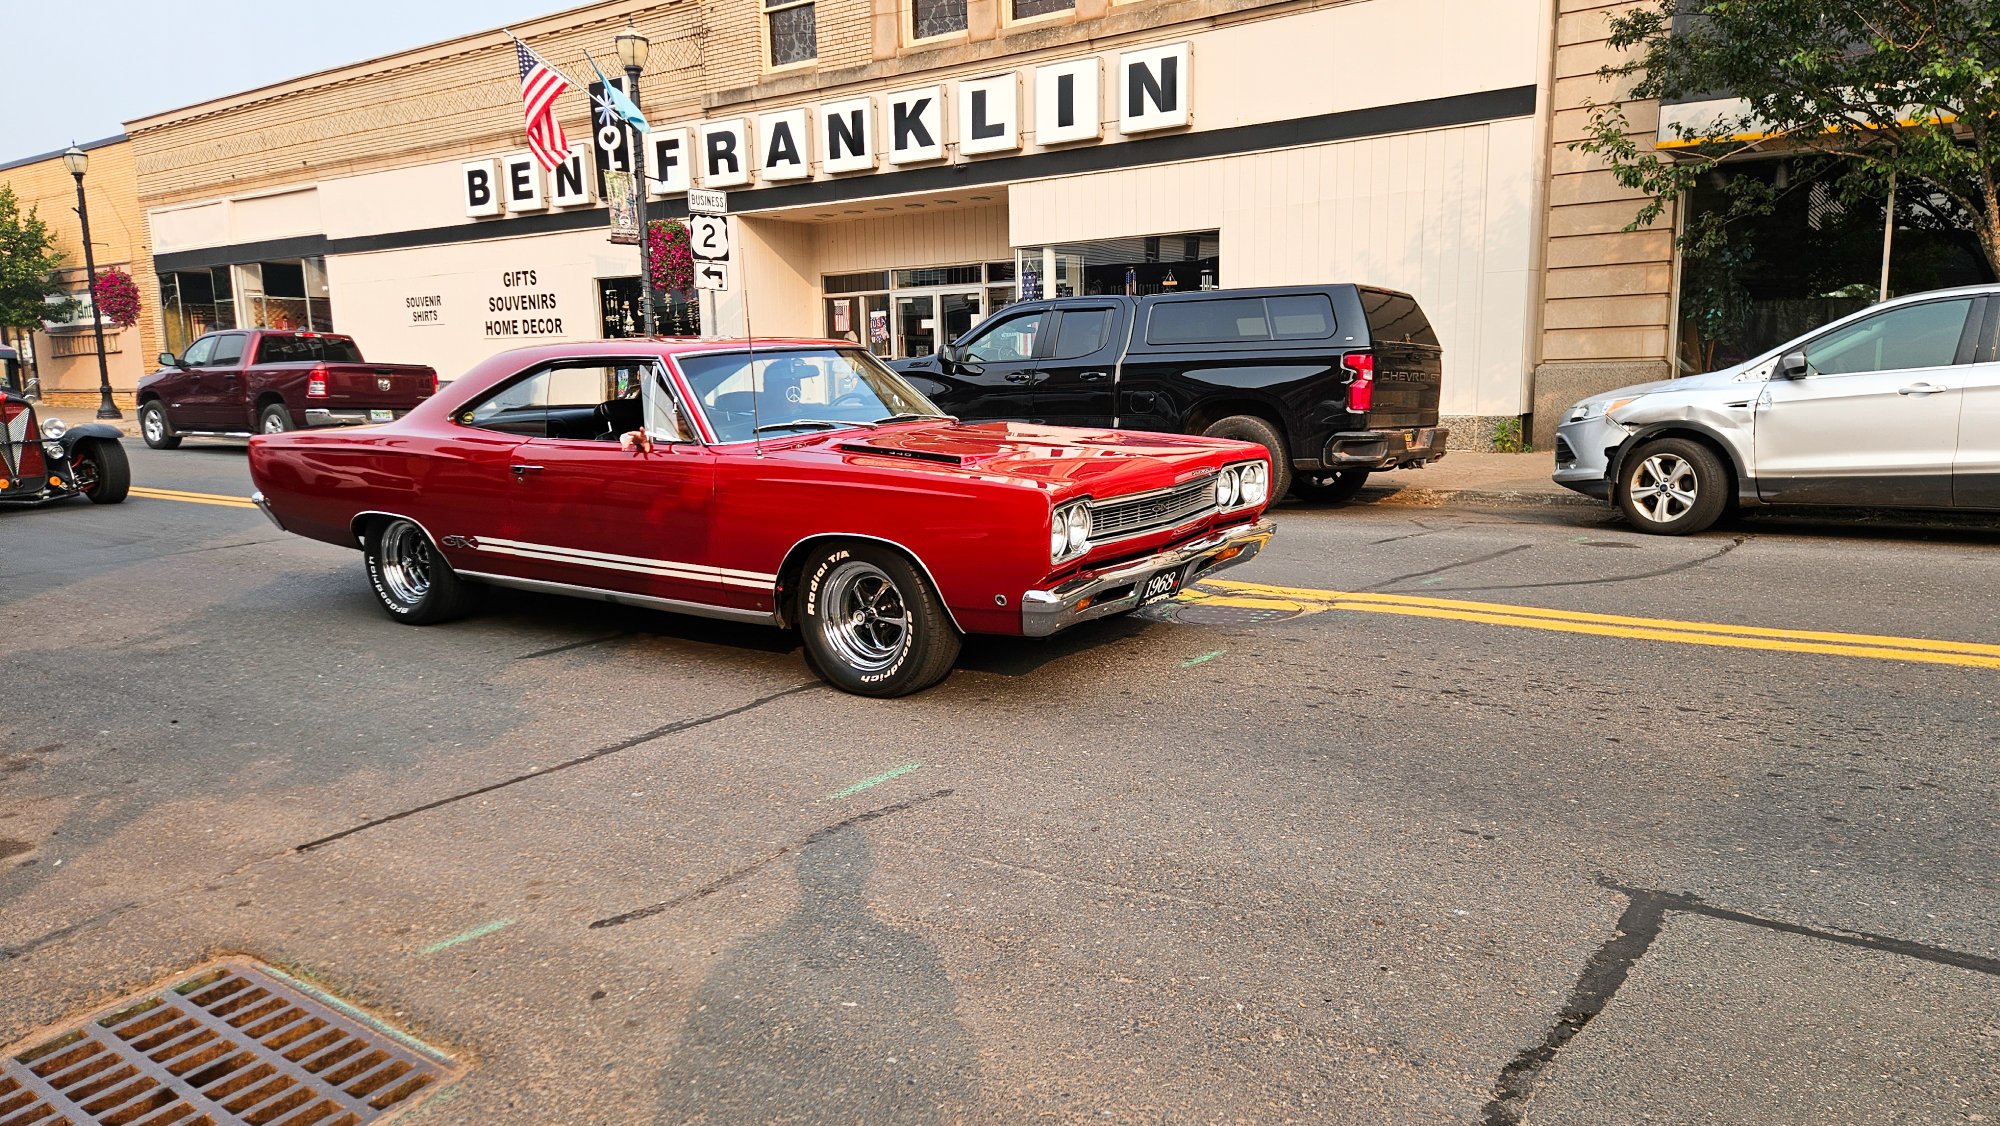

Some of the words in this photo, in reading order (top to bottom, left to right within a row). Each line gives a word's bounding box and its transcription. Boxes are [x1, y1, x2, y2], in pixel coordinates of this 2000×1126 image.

[467, 157, 583, 207] BEN
[656, 56, 1178, 182] FRANKLIN
[691, 194, 724, 208] BUSINESS
[702, 224, 716, 248] 2
[503, 270, 537, 288] GIFTS
[406, 295, 442, 308] SOUVENIR
[489, 293, 557, 312] SOUVENIRS
[412, 310, 438, 322] SHIRTS
[485, 319, 519, 336] HOME
[522, 318, 563, 335] DECOR
[1381, 371, 1440, 382] CHEVROLET
[441, 534, 476, 549] GTX
[807, 563, 829, 616] Radial
[828, 549, 851, 563] T/A
[1143, 571, 1176, 599] 1968
